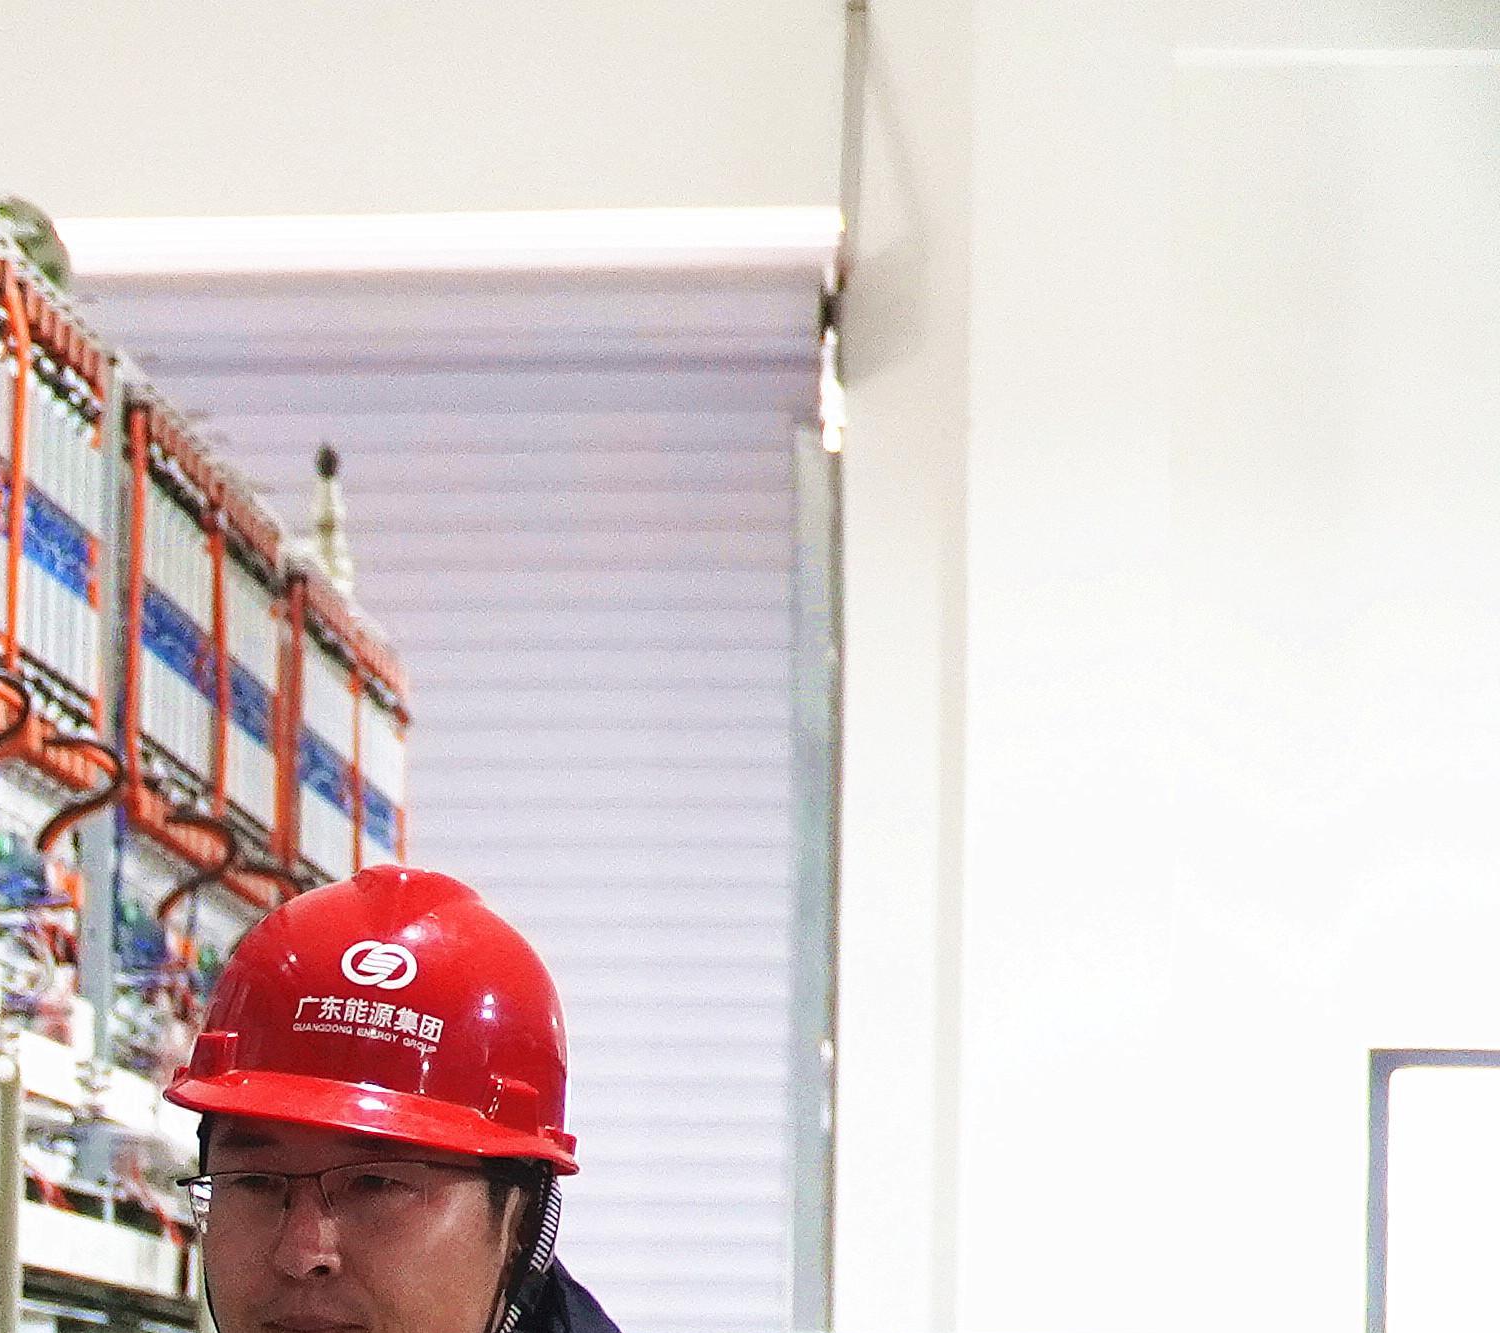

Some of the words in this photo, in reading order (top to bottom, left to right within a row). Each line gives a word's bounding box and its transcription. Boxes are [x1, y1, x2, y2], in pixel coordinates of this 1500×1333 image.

[292, 1022, 353, 1035] GUANGDONG
[294, 995, 444, 1043] 广东能源集团
